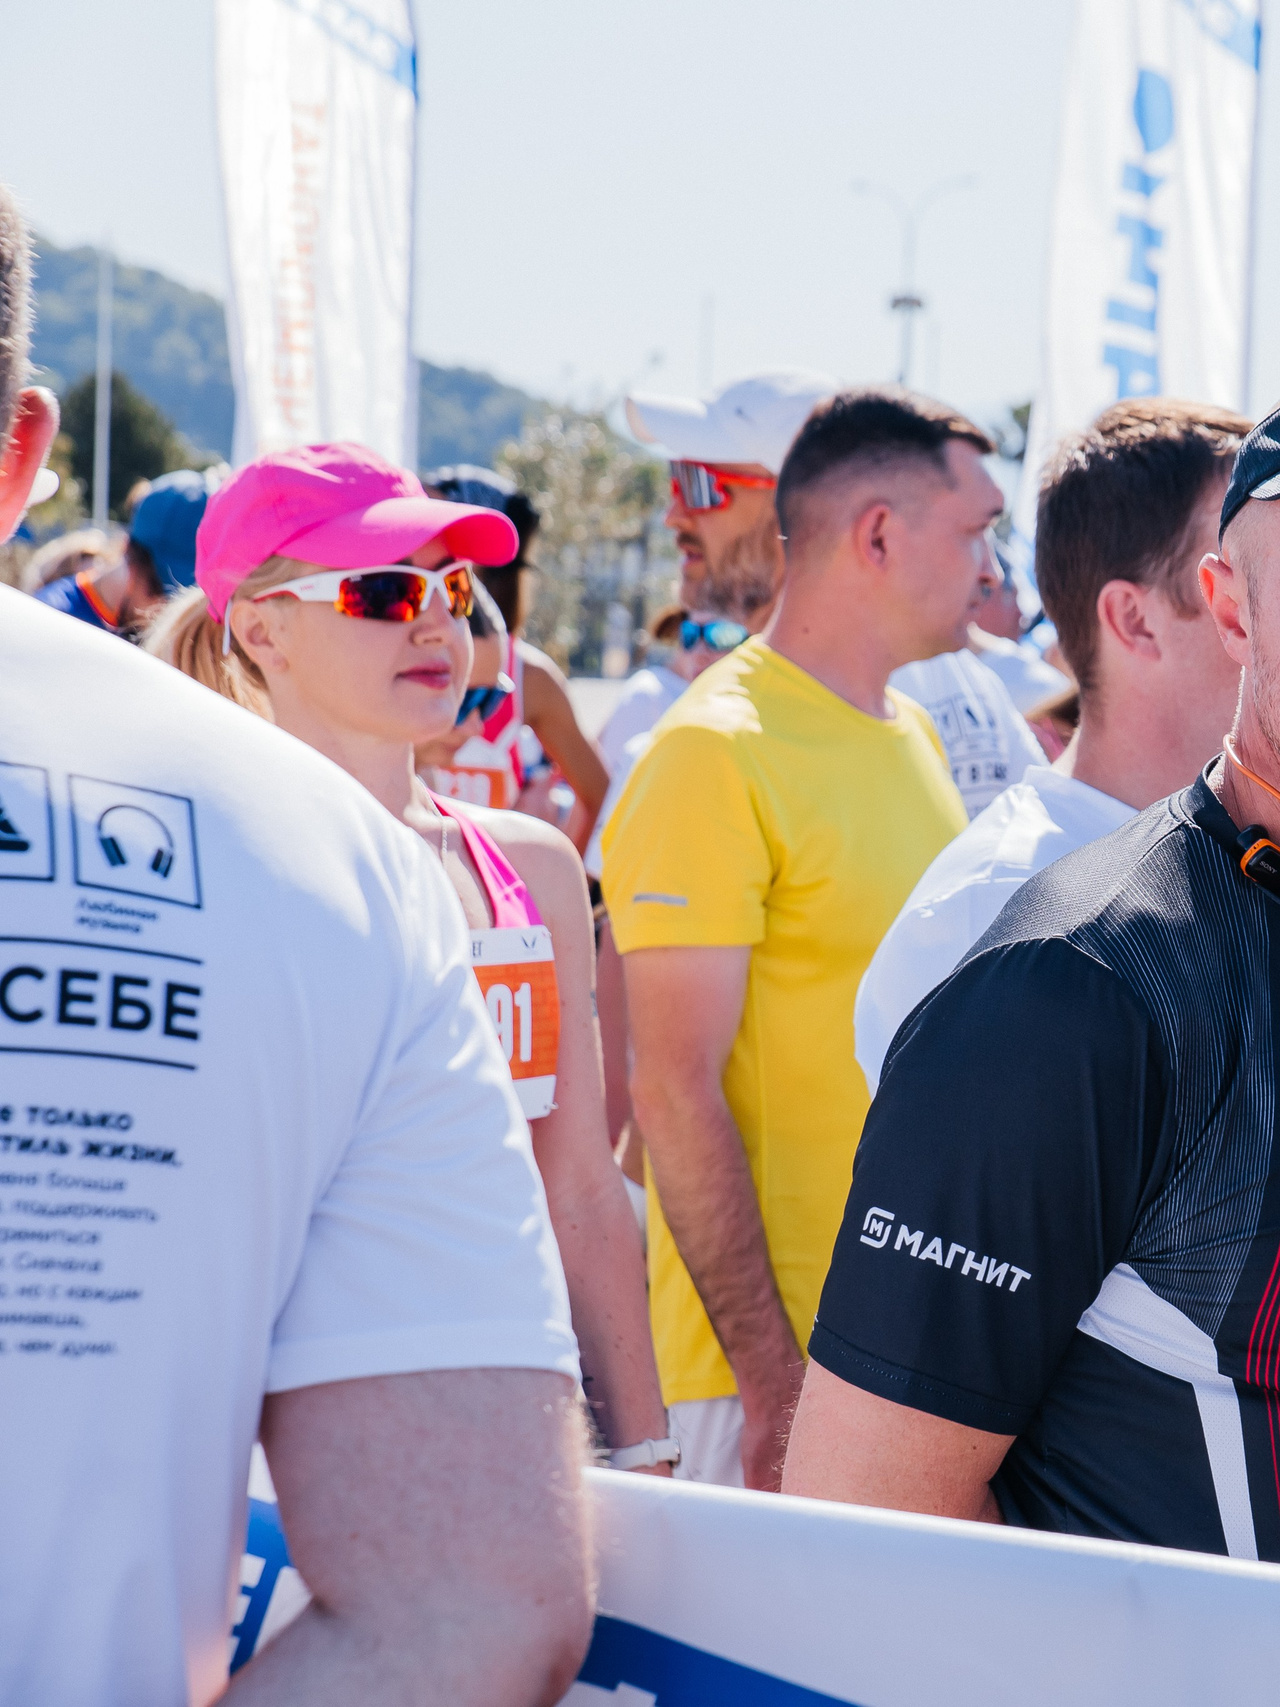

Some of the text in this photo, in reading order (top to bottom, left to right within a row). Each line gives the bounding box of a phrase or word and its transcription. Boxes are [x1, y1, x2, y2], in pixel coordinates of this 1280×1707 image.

[1259, 860, 1277, 874] SONY
[0, 965, 202, 1041] СЕБЕ
[27, 1106, 133, 1132] ТОЛЬКО
[0, 1134, 70, 1156] ТИЛЬ
[893, 1223, 1032, 1293] МАГНИТ
